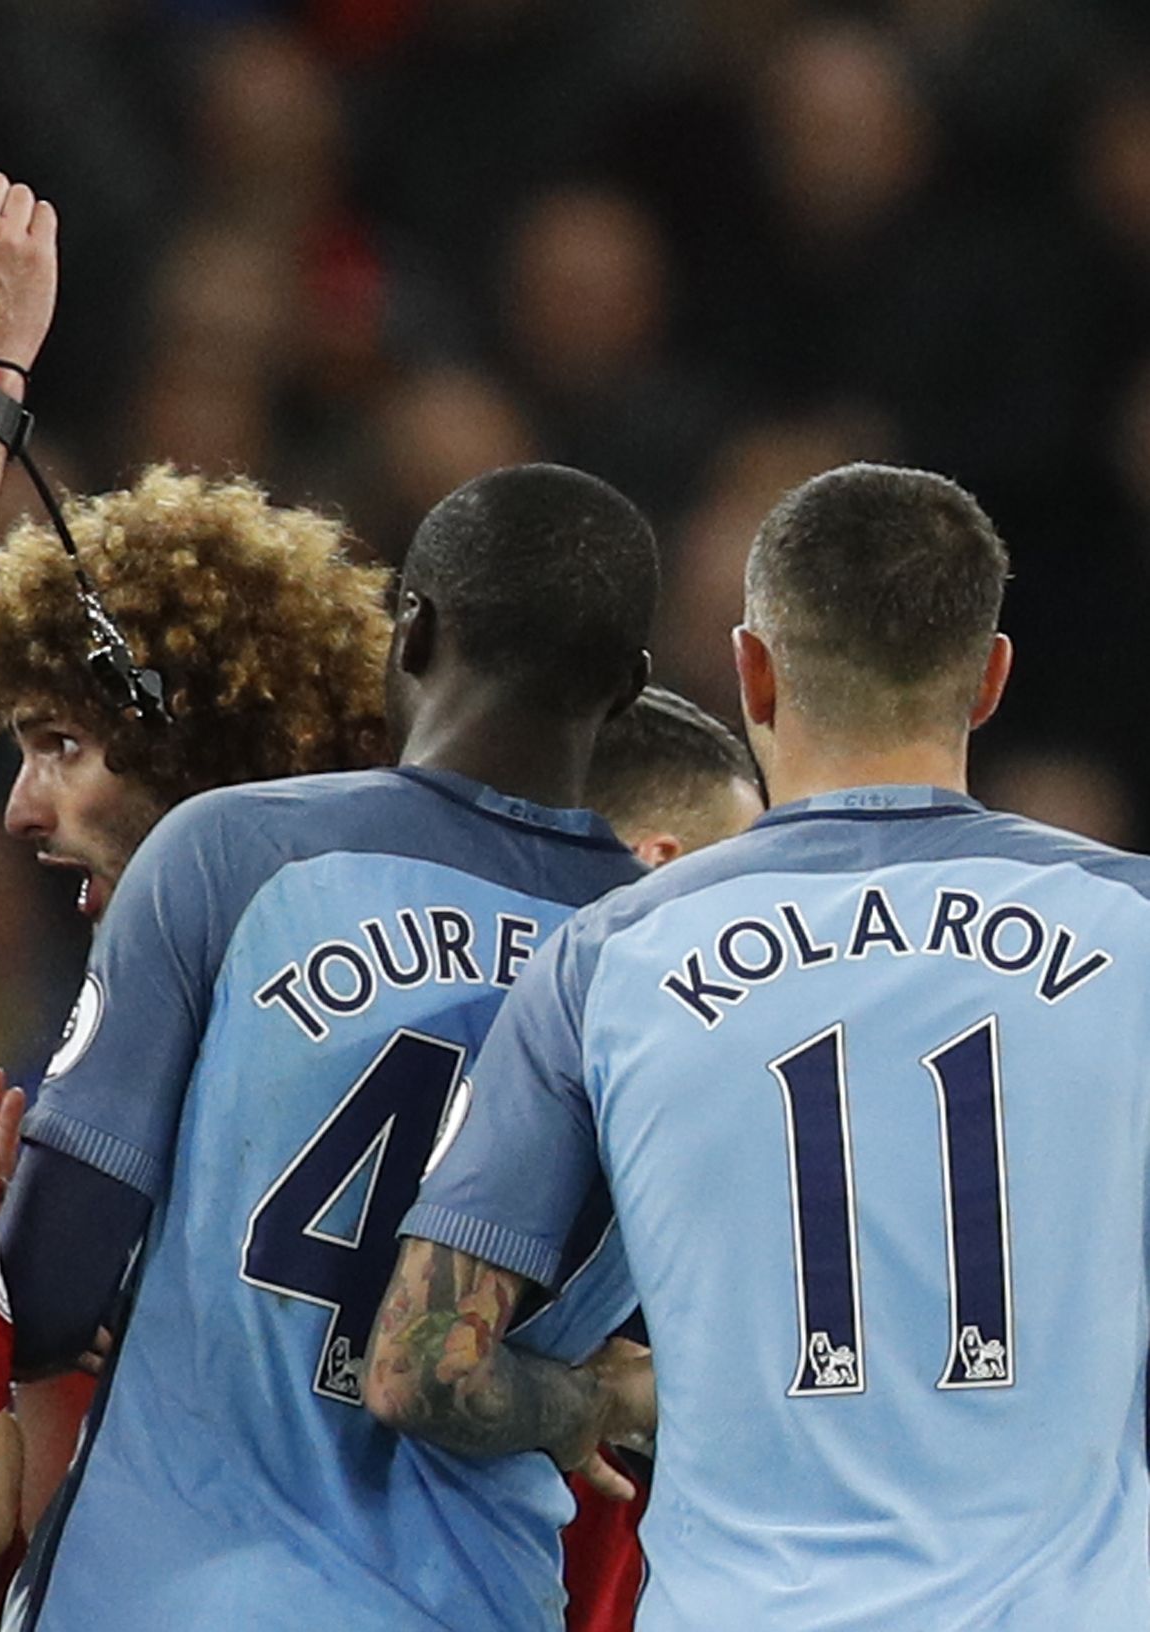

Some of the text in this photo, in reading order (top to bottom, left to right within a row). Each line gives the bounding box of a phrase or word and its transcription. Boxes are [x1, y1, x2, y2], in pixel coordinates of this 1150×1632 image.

[254, 906, 538, 1042] TOURE
[661, 886, 1113, 1030] KOLAROV
[240, 1027, 466, 1406] 4
[768, 1013, 1014, 1398] 11
